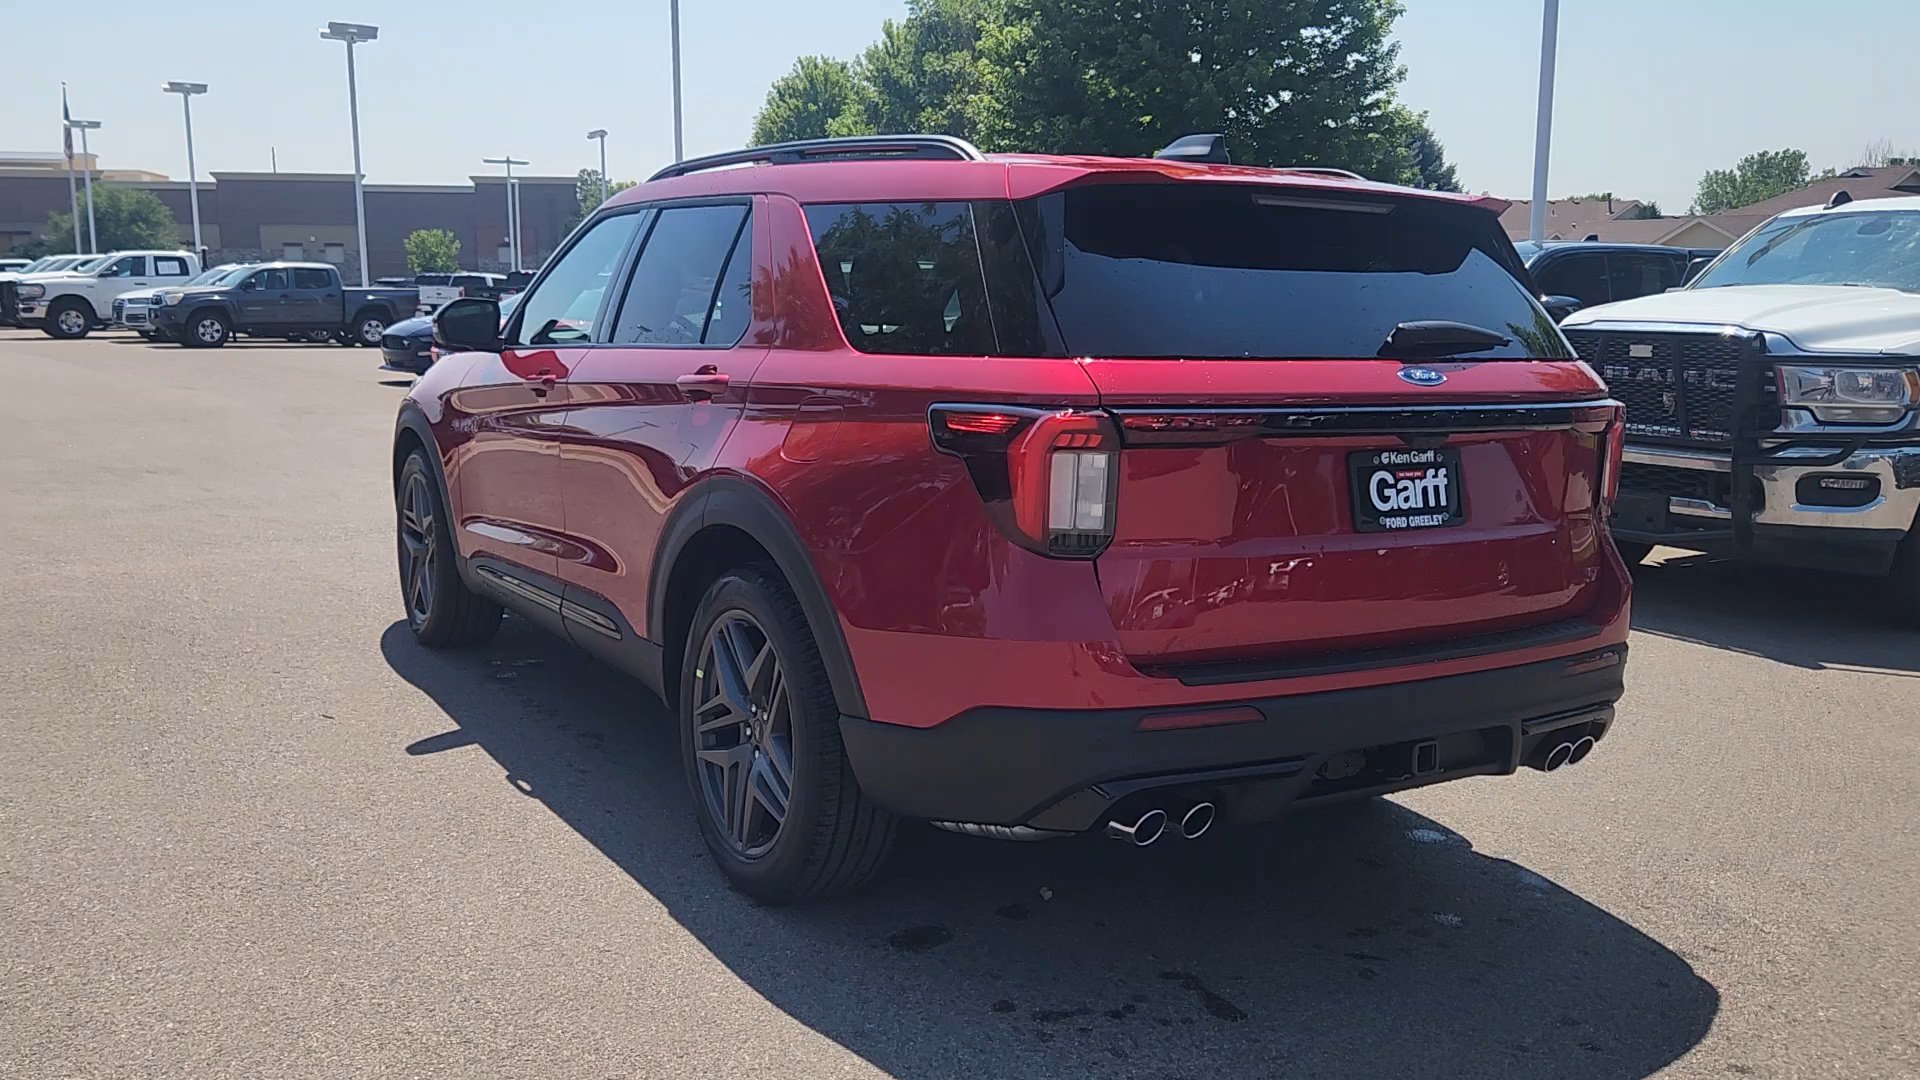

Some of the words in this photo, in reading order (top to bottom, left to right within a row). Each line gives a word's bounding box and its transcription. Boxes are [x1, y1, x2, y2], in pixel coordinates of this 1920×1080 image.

[1390, 452, 1410, 464] Ken
[1411, 450, 1435, 463] Garff
[1369, 468, 1448, 511] Garff
[1386, 516, 1408, 529] FORD
[1408, 514, 1443, 526] GREELEY
